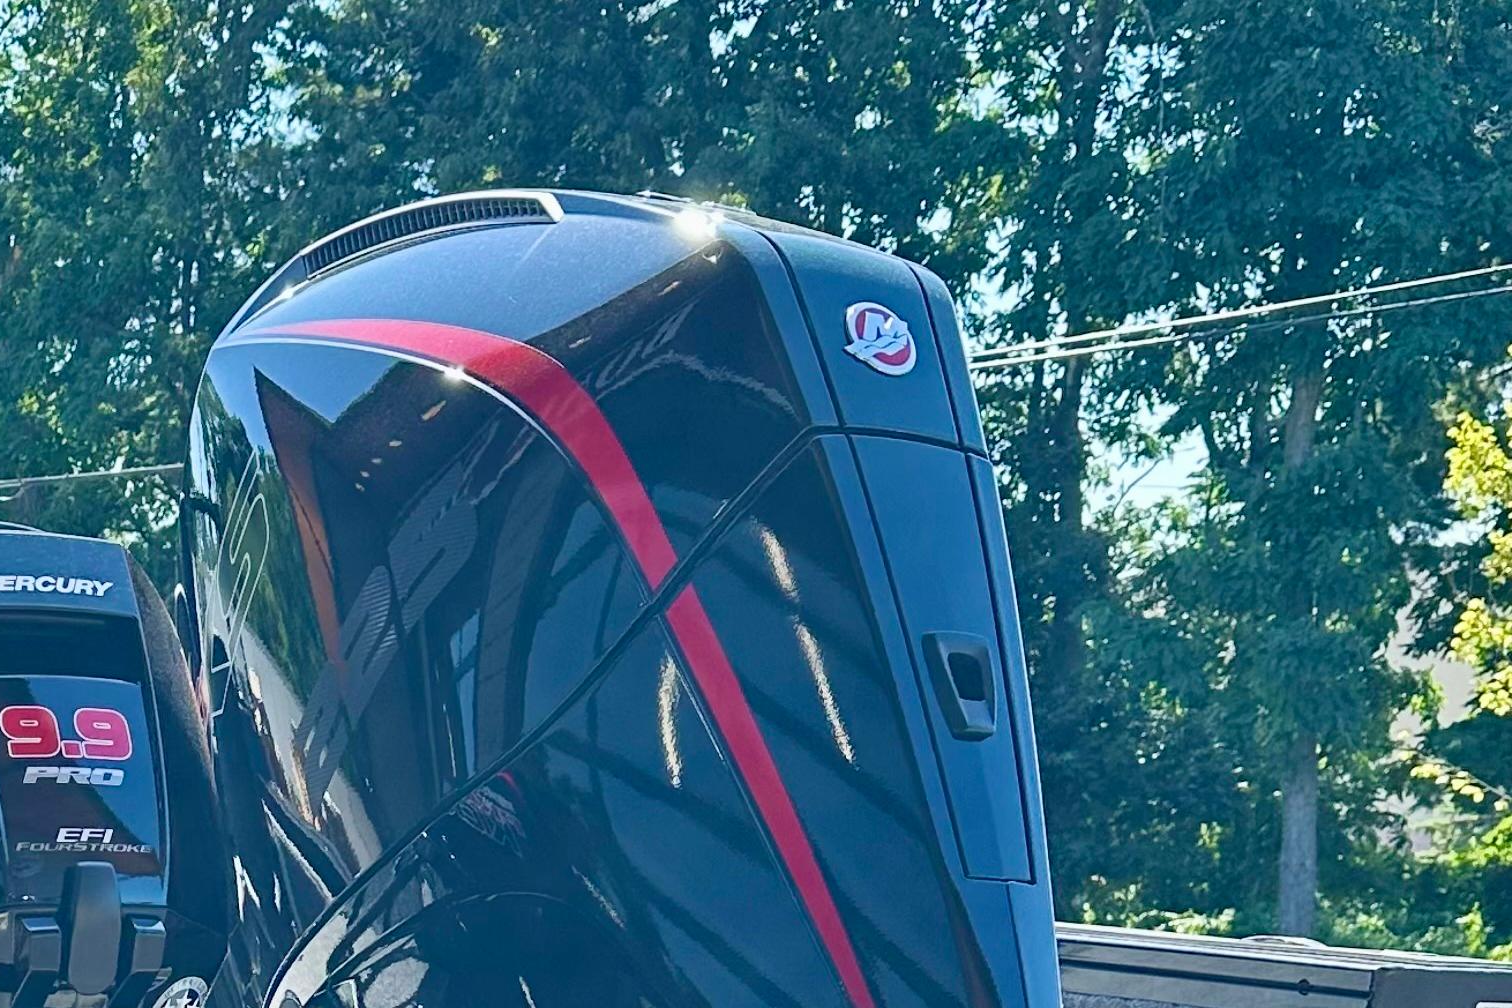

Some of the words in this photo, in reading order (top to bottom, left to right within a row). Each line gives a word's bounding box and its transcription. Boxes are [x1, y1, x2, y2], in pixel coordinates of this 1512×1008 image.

[0, 705, 132, 760] 9.9
[23, 766, 124, 786] PRO
[56, 827, 114, 843] EFI
[16, 841, 152, 854] FOURSTROKE
